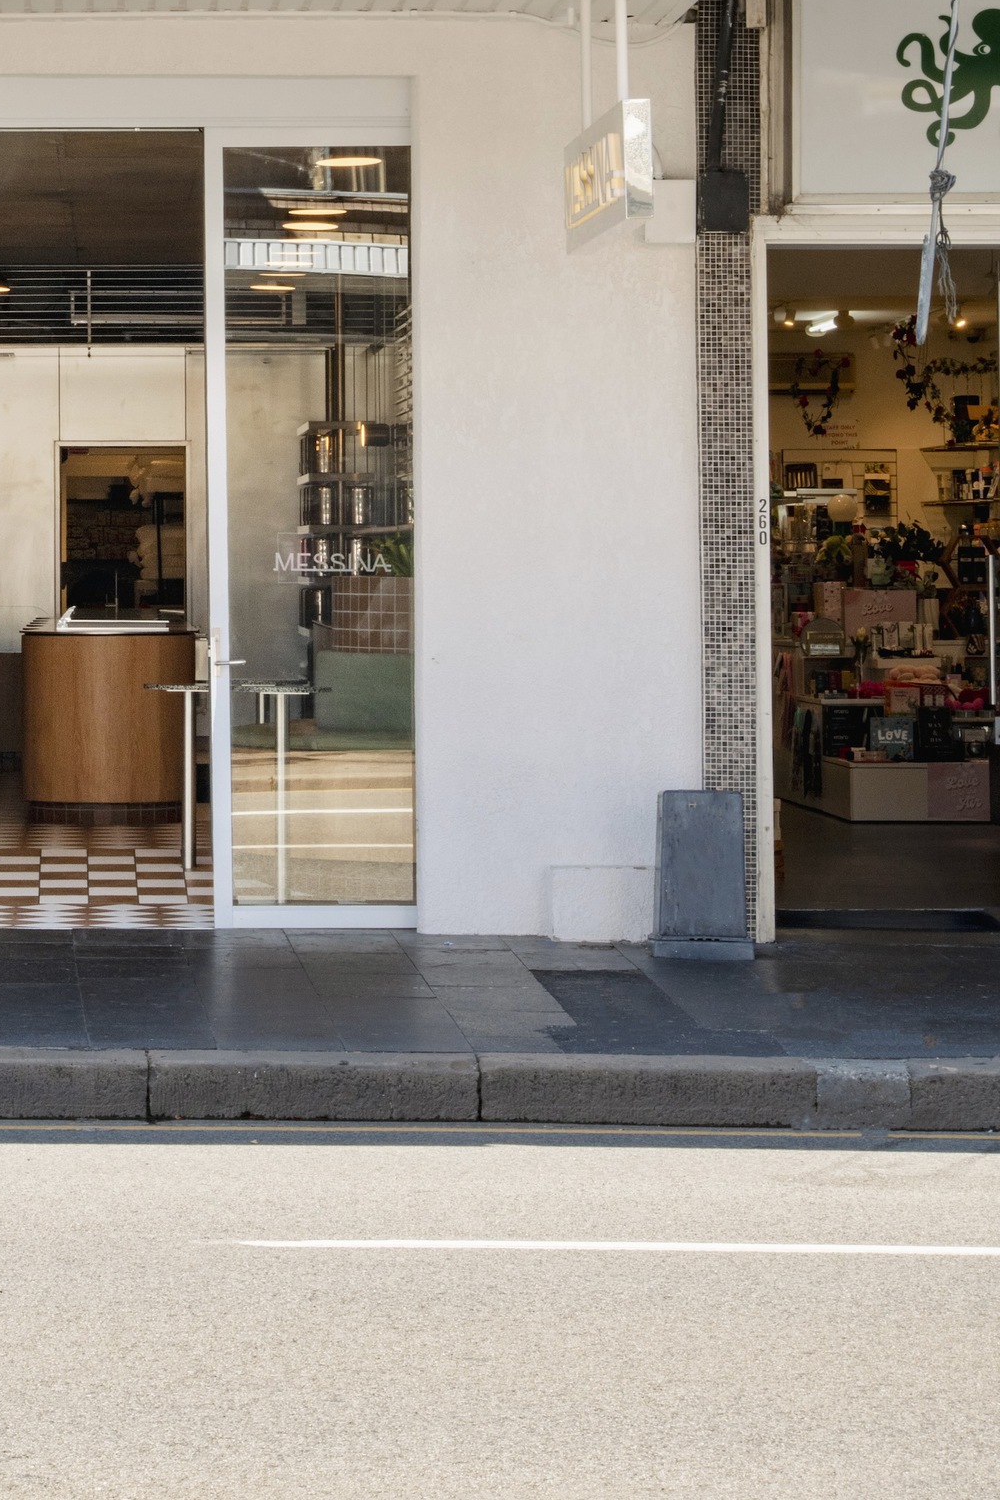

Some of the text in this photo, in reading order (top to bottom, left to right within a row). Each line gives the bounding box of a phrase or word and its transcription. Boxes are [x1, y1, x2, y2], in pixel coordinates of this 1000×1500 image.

[273, 553, 391, 572] MESSINA
[878, 729, 908, 740] LOVE
[947, 776, 980, 790] Love
